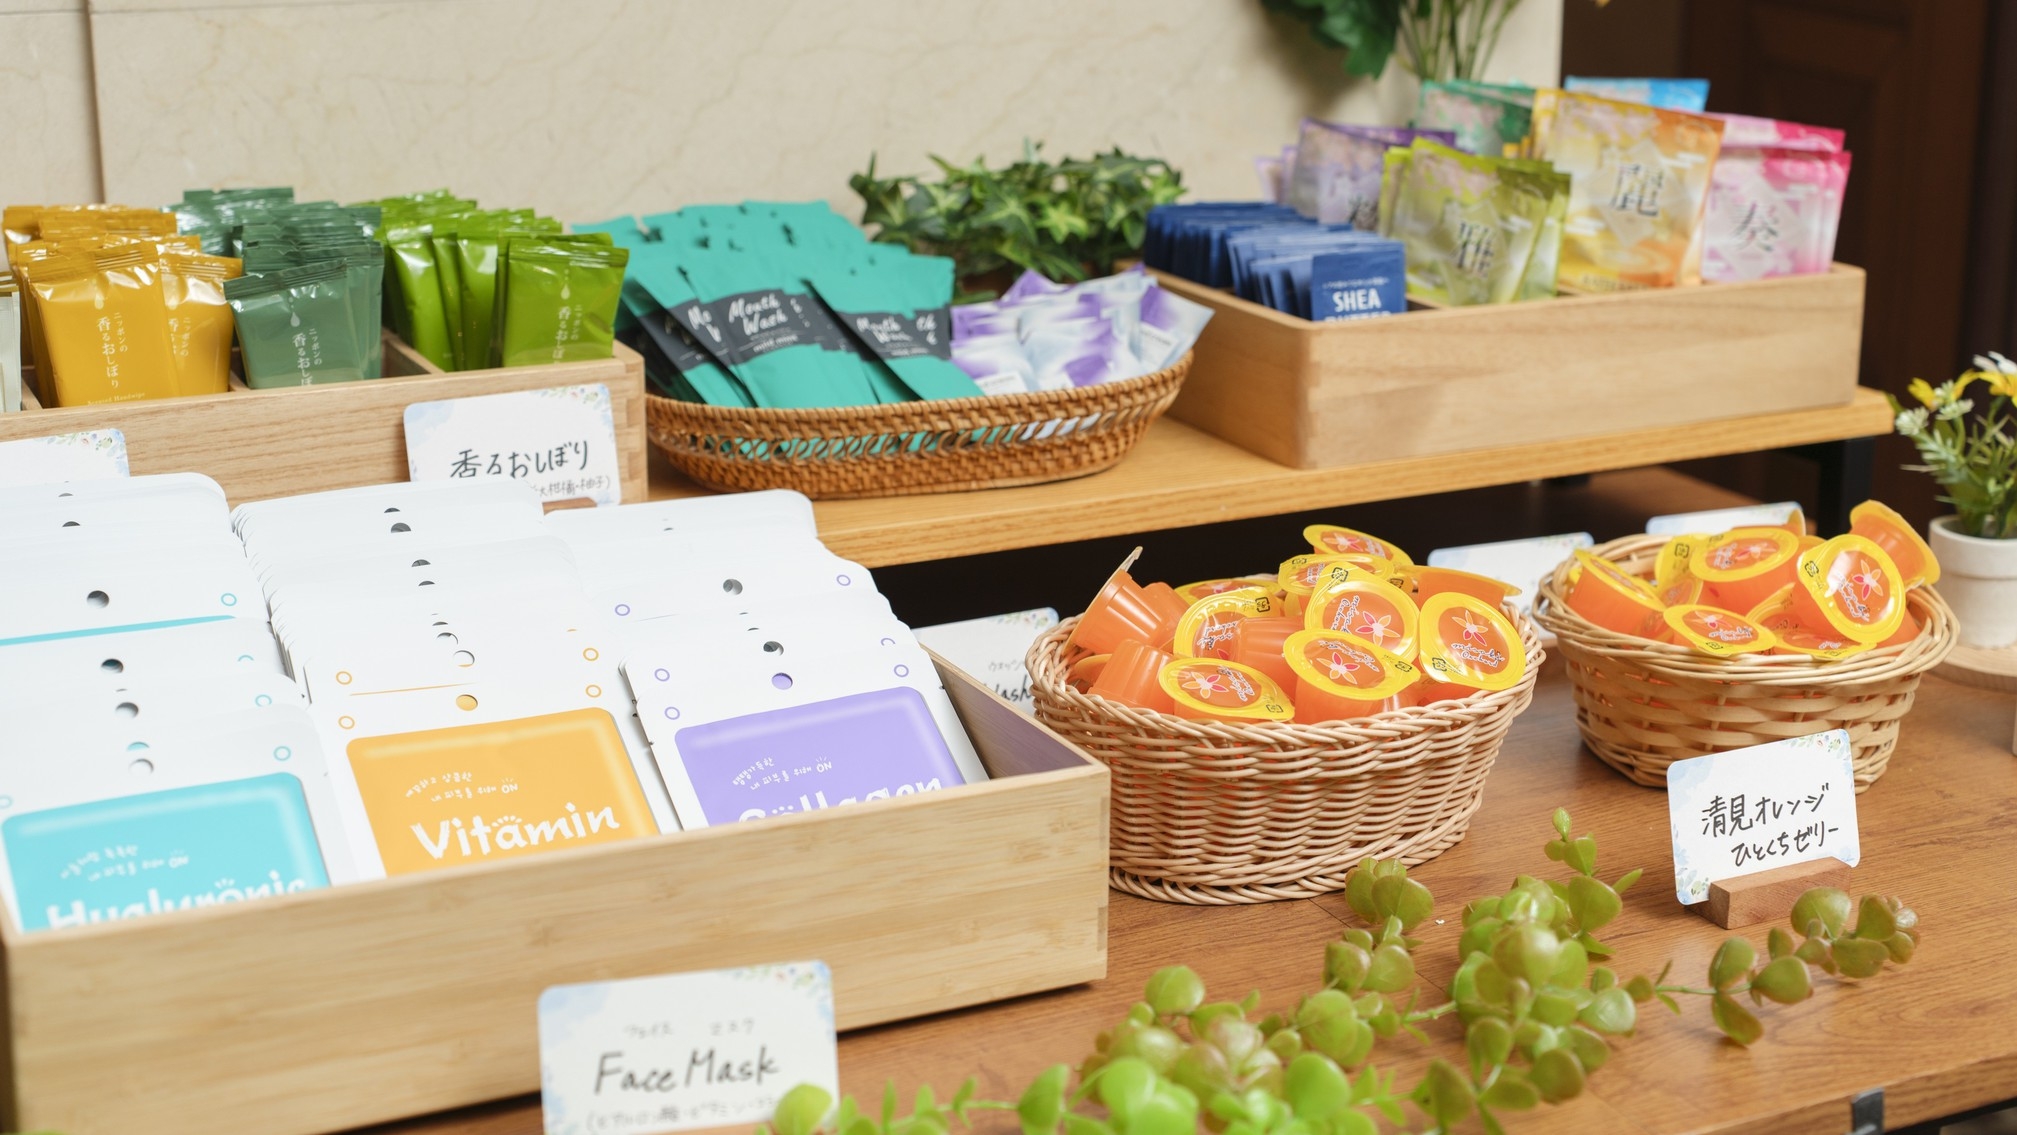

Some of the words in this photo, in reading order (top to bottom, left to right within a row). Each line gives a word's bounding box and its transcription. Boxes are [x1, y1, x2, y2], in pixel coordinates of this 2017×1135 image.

[729, 293, 780, 323] Mouth
[1332, 288, 1382, 313] SHEA
[743, 309, 788, 336] Wash
[96, 315, 120, 389] 香るおしぼり
[292, 332, 314, 386] 香るおしぼ
[450, 440, 589, 479] 香るおしぼり
[816, 761, 832, 773] ON
[501, 783, 519, 794] ON
[738, 777, 942, 823] Cllen
[410, 802, 620, 860] Vitamin
[1701, 782, 1830, 838] 清見オレンジ
[168, 854, 190, 869] ON
[1730, 821, 1840, 868] ひとくちゼリー
[593, 1050, 677, 1095] Face
[684, 1045, 780, 1088] Mask
